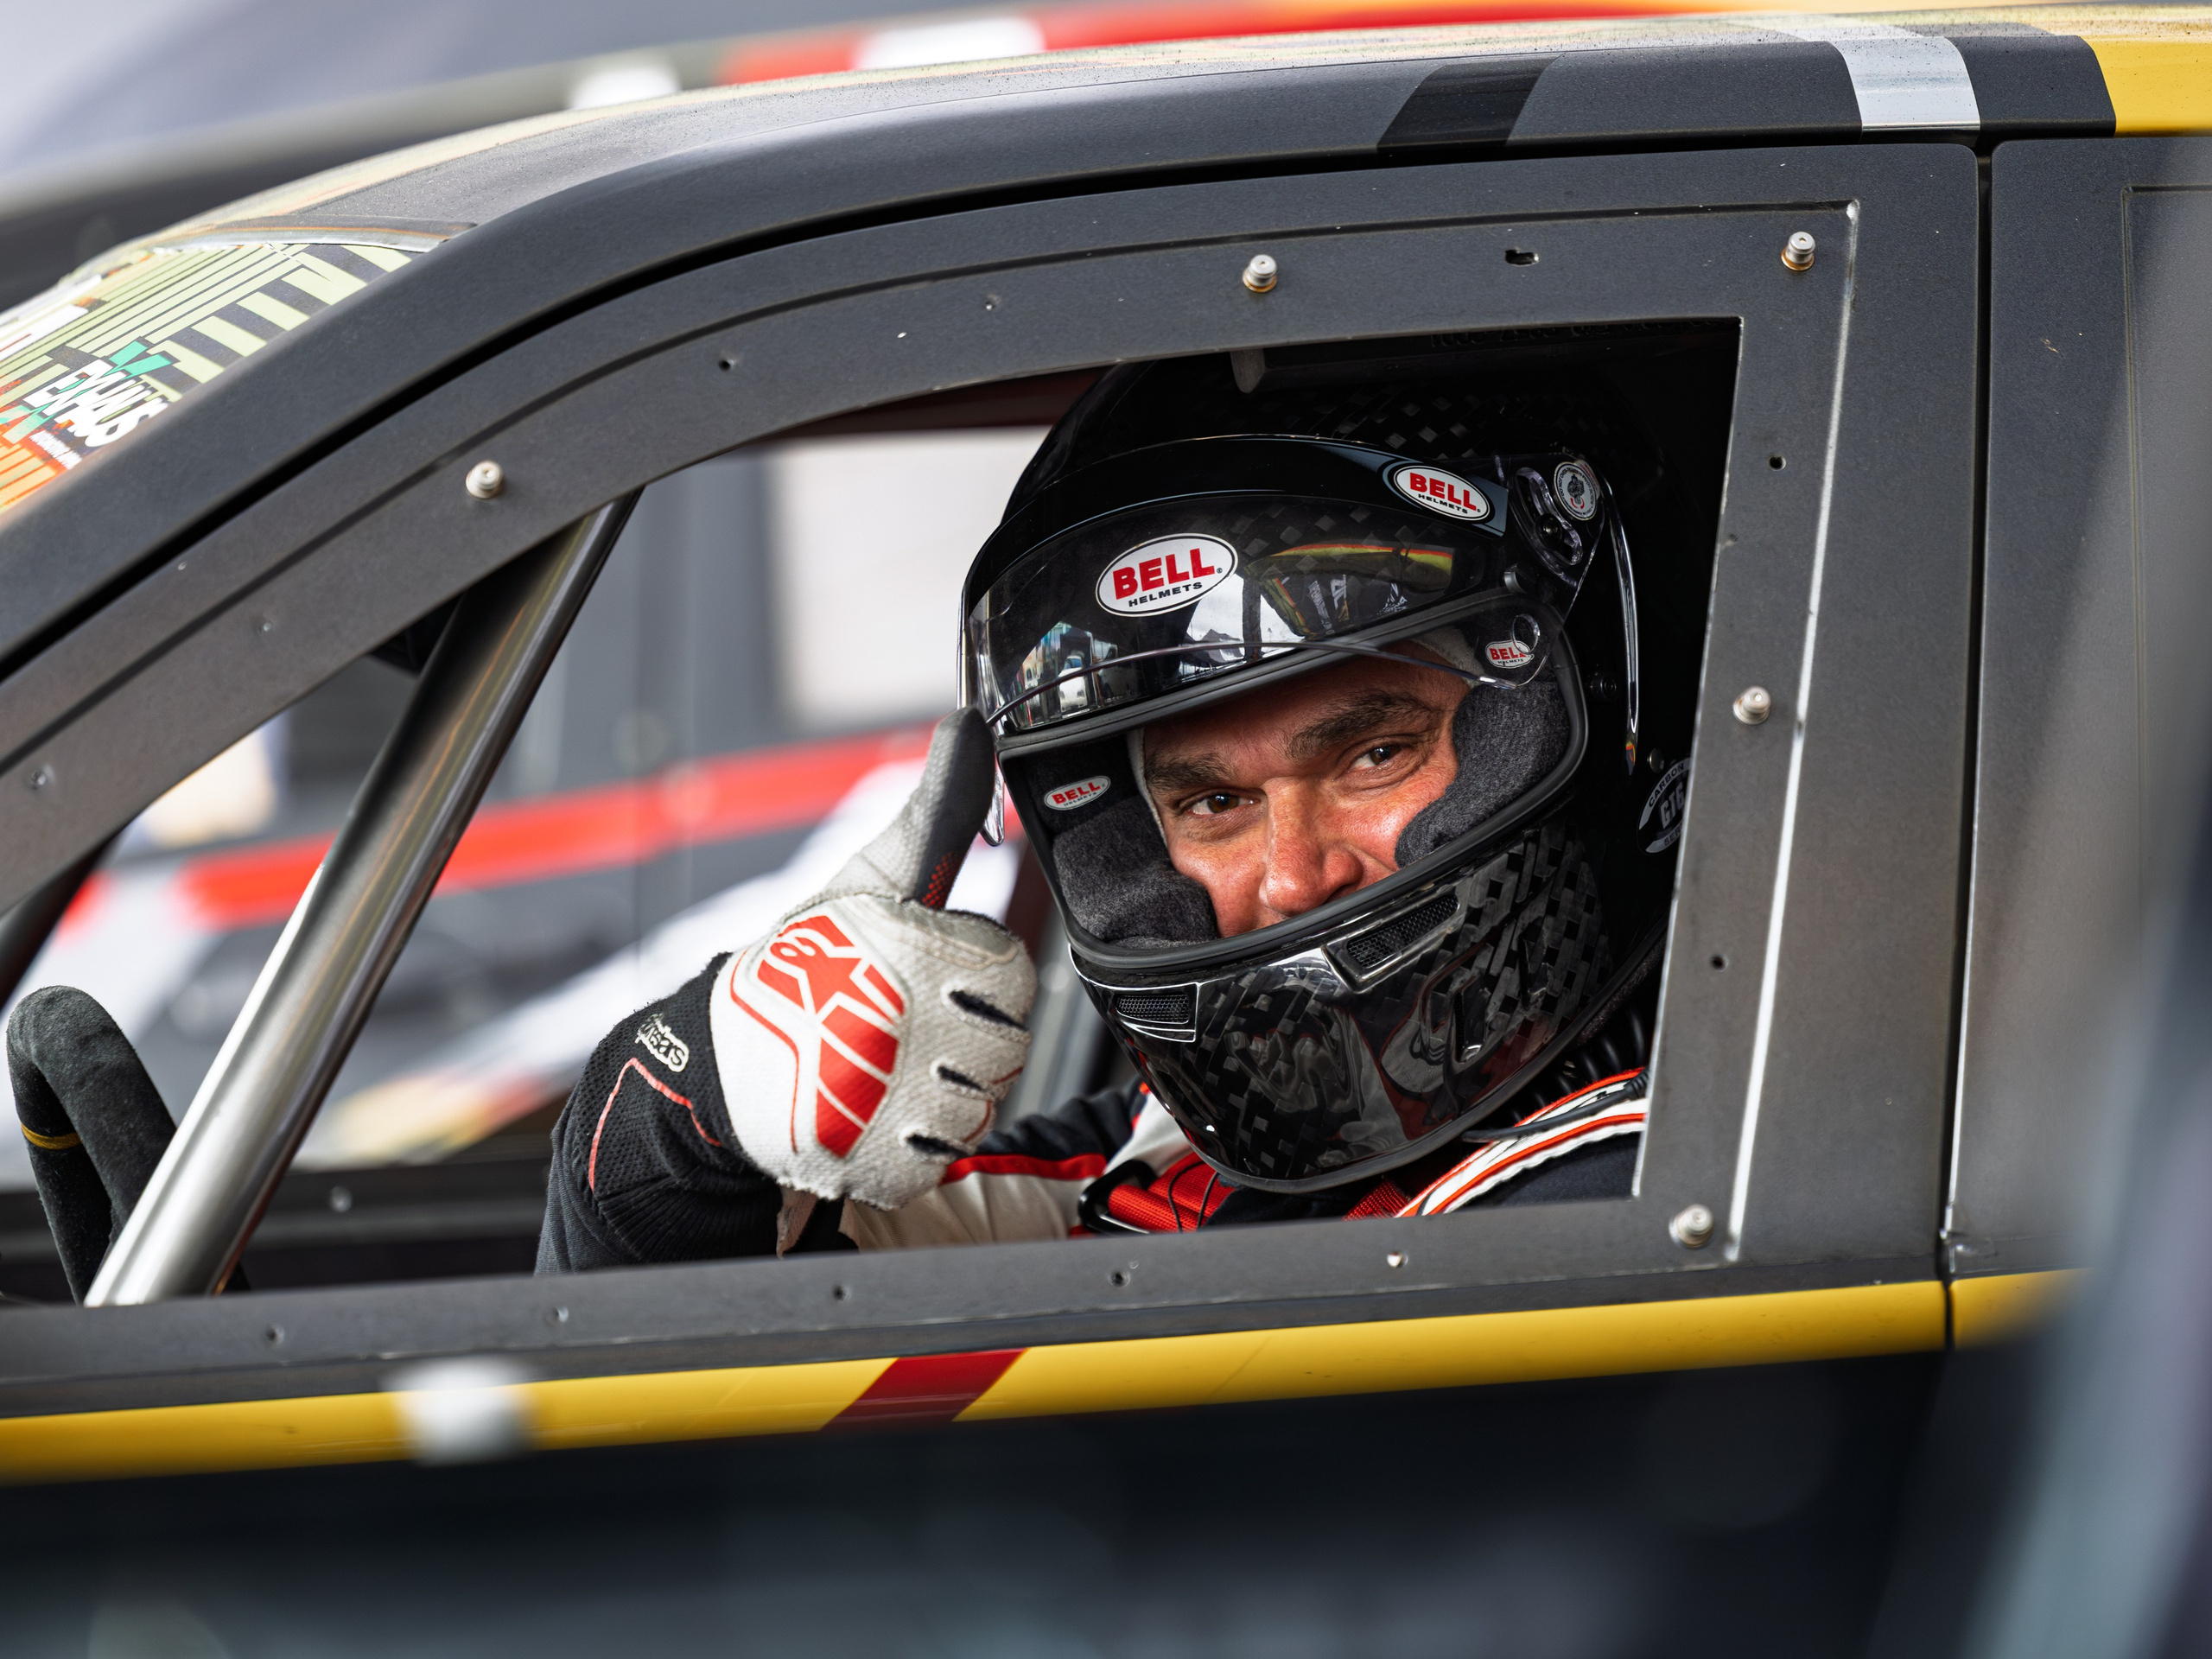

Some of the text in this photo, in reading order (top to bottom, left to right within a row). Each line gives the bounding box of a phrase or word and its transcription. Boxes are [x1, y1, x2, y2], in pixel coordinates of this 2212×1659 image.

[1409, 472, 1477, 512] BELL
[1418, 493, 1468, 514] HELMETS
[1112, 548, 1216, 601] BELL
[1128, 582, 1203, 607] HELMETS
[1052, 782, 1102, 804] BELL
[1649, 763, 1685, 808] CARBON
[1064, 792, 1097, 807] HELMETS
[1664, 825, 1681, 847] SER
